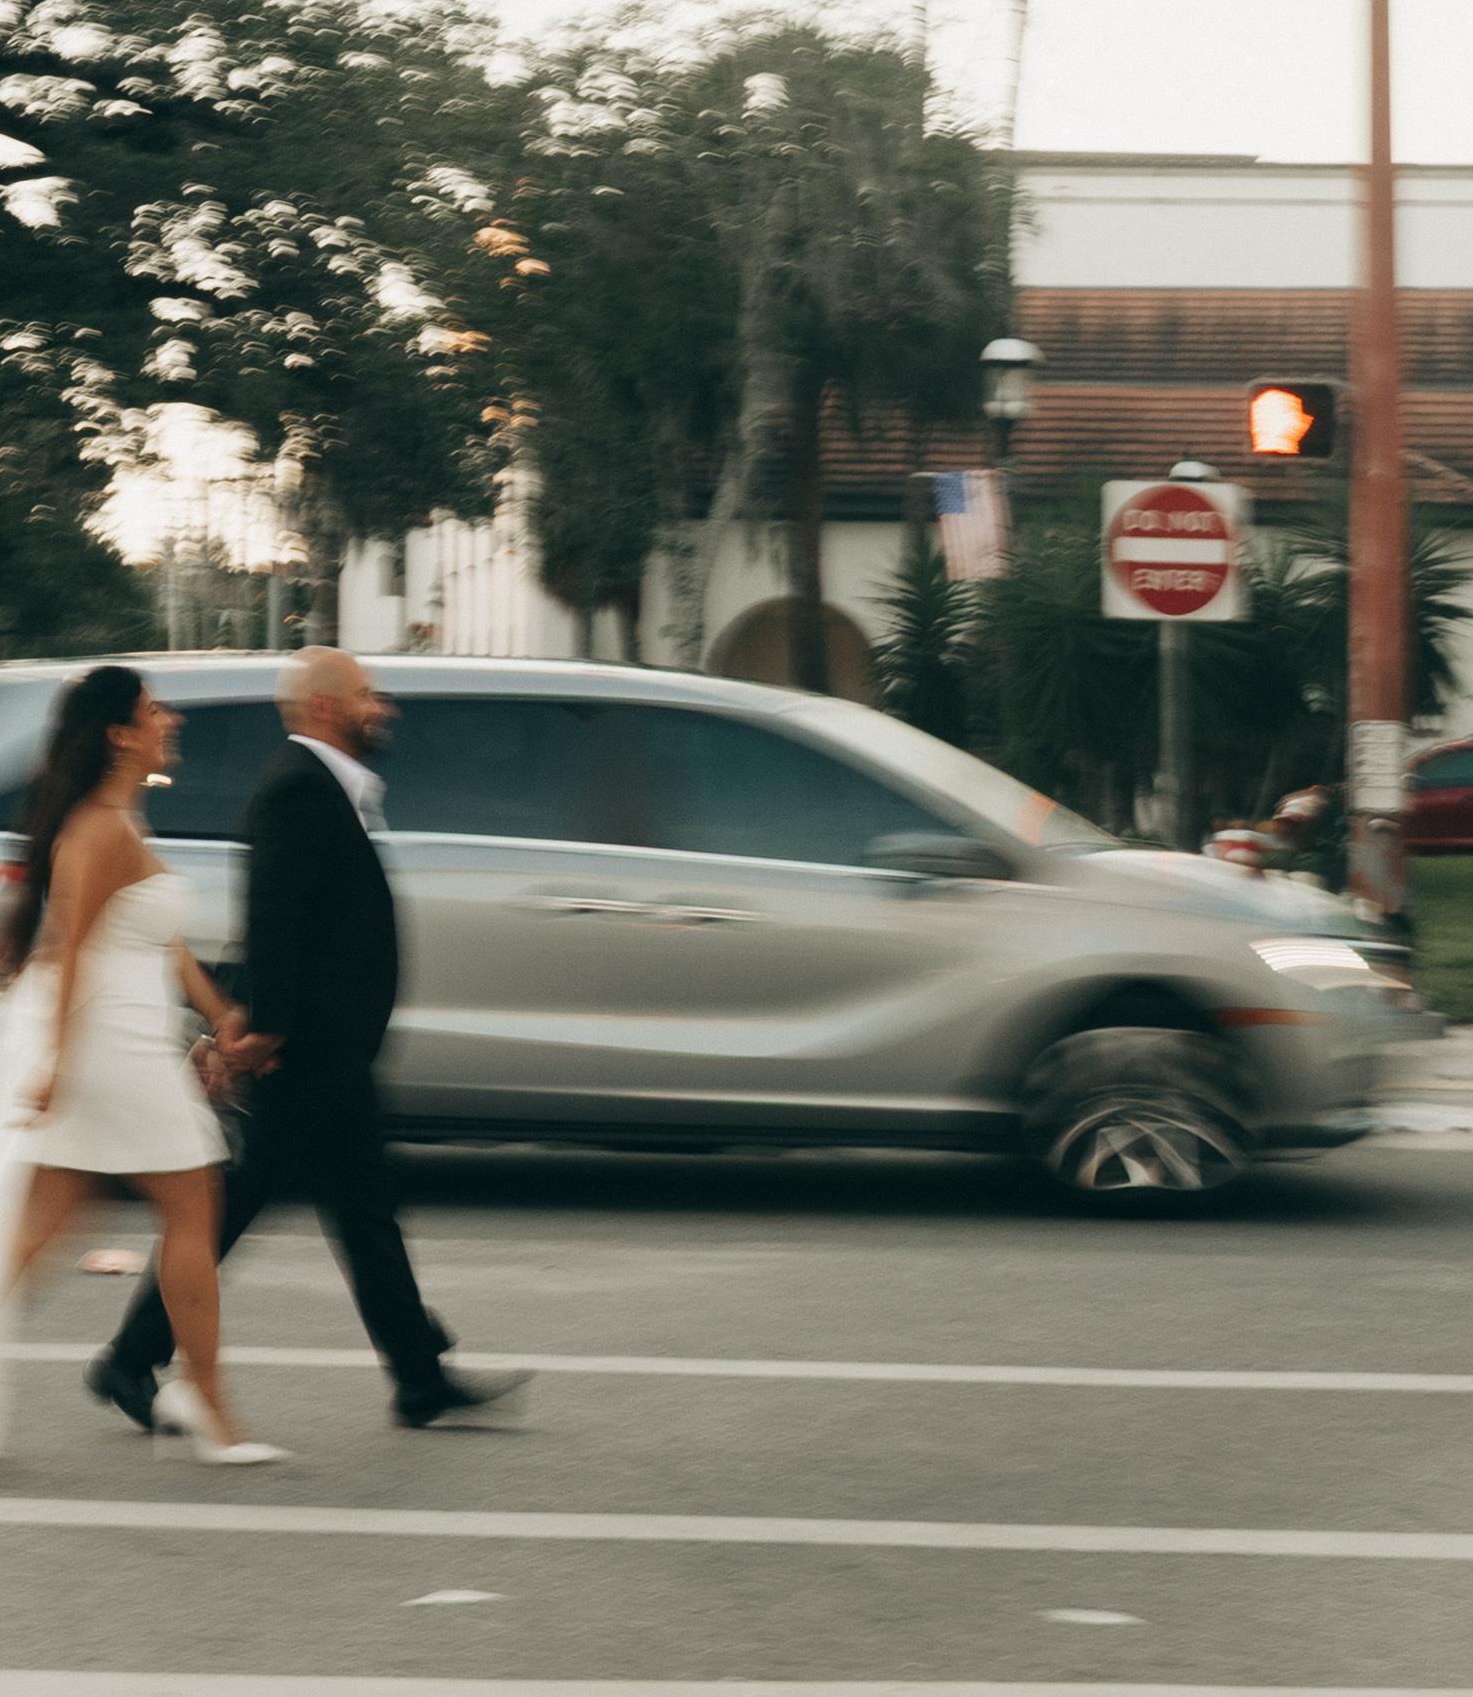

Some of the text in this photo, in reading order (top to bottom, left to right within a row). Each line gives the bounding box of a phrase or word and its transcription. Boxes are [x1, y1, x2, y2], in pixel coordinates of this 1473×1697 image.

[1122, 509, 1220, 533] DO NOT
[1131, 567, 1221, 593] ENTER
